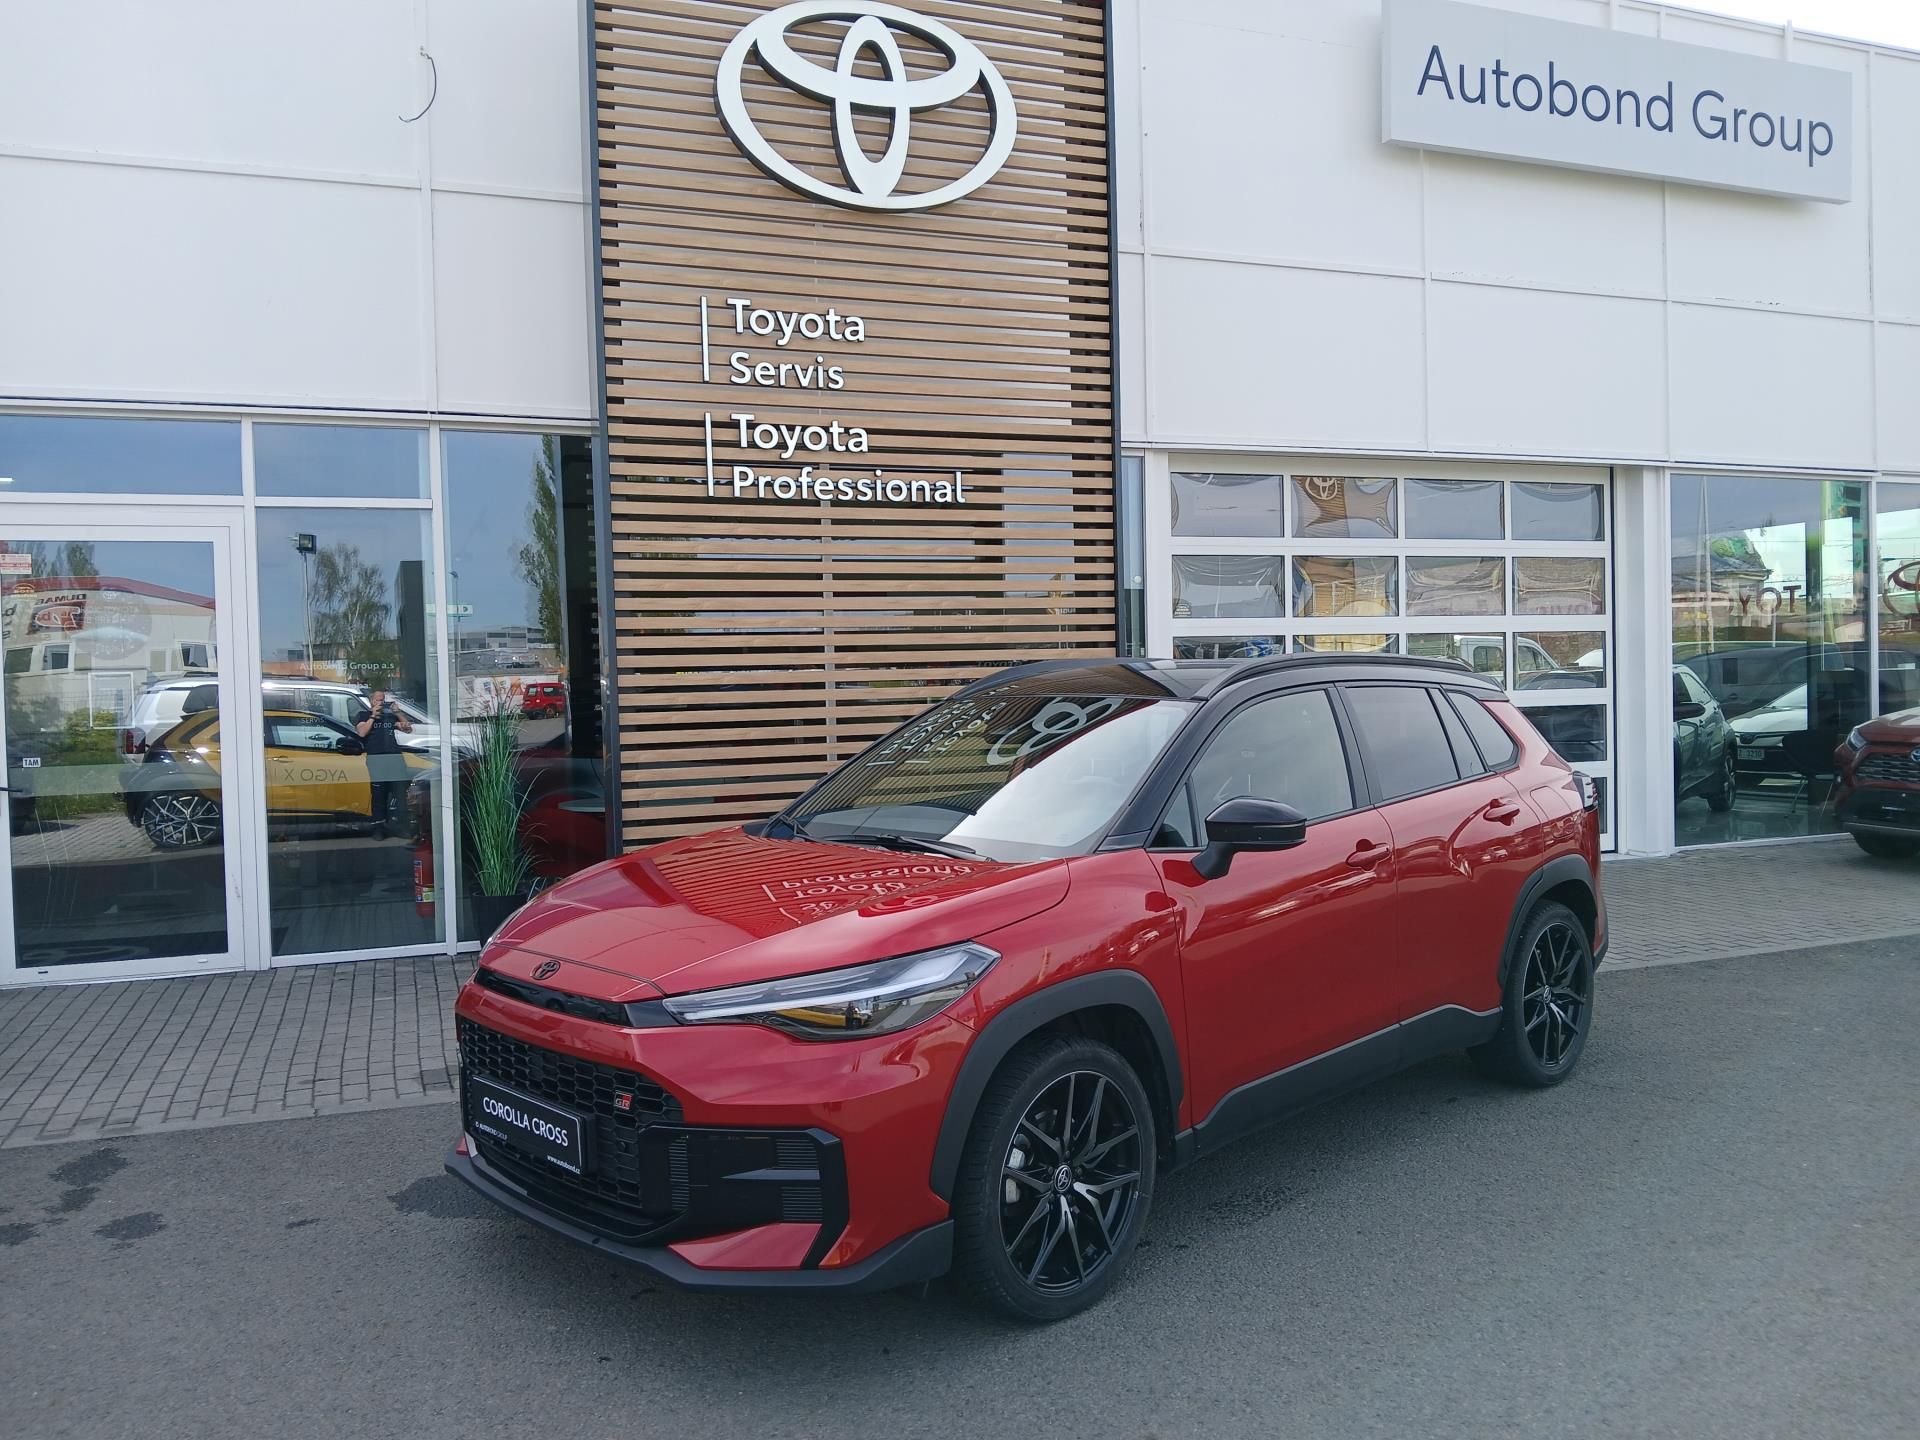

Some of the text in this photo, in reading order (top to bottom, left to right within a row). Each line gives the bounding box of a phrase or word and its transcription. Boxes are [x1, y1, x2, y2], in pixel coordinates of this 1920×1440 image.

[1416, 43, 1835, 168] Autobond Group
[726, 297, 866, 346] Toyota
[729, 351, 845, 390] Servis
[730, 413, 869, 459] Toyota
[732, 466, 966, 503] Professional
[349, 662, 380, 671] Group
[482, 1096, 569, 1147] COROLLA CROSS
[615, 1094, 632, 1110] GR
